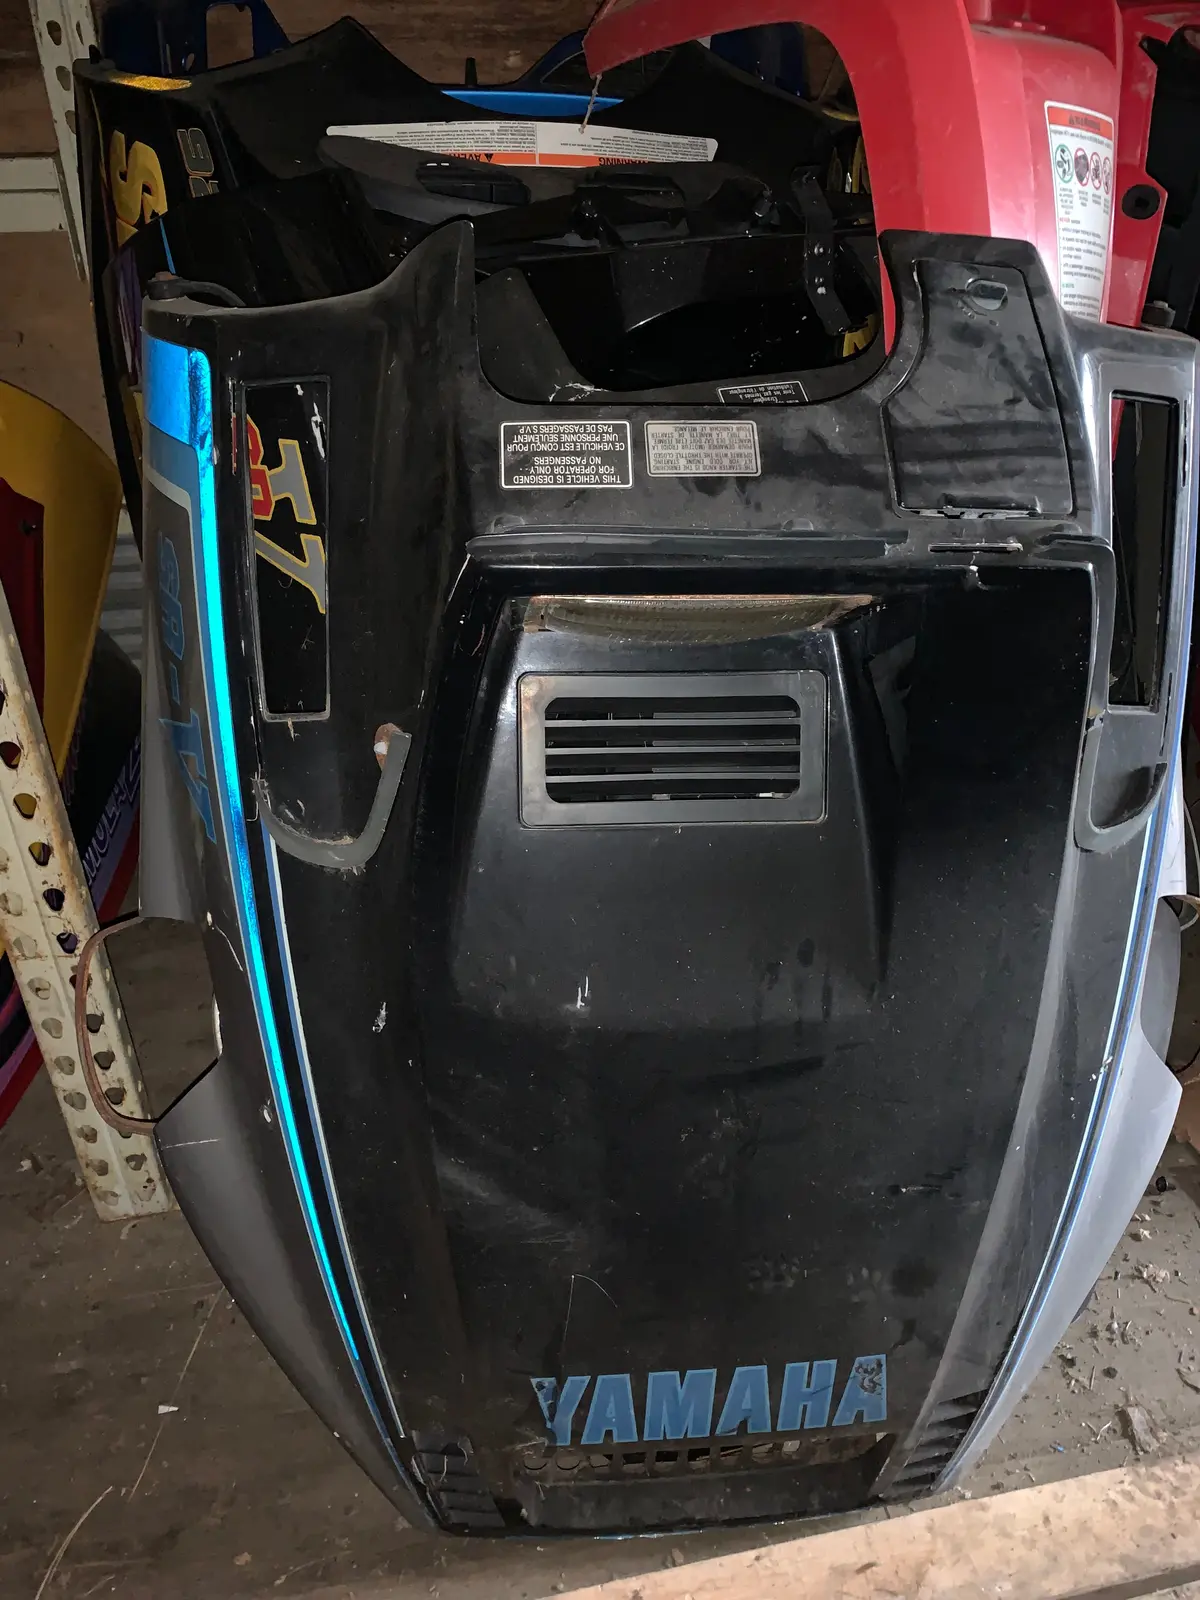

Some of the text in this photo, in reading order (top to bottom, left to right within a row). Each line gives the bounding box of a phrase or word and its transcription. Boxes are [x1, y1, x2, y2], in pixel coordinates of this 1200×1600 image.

[598, 157, 648, 166] RNING
[540, 425, 584, 433] PASSAGERS
[586, 425, 596, 433] DE
[598, 425, 612, 433] PAS
[513, 434, 618, 442] UNE PERSONNE SEULEMENT
[507, 442, 625, 452] CE VEHICULE EST CONÇU POUR
[513, 475, 621, 483] THIS VEHICLE IS DESIGNED
[530, 1353, 888, 1447] YAMAHA
